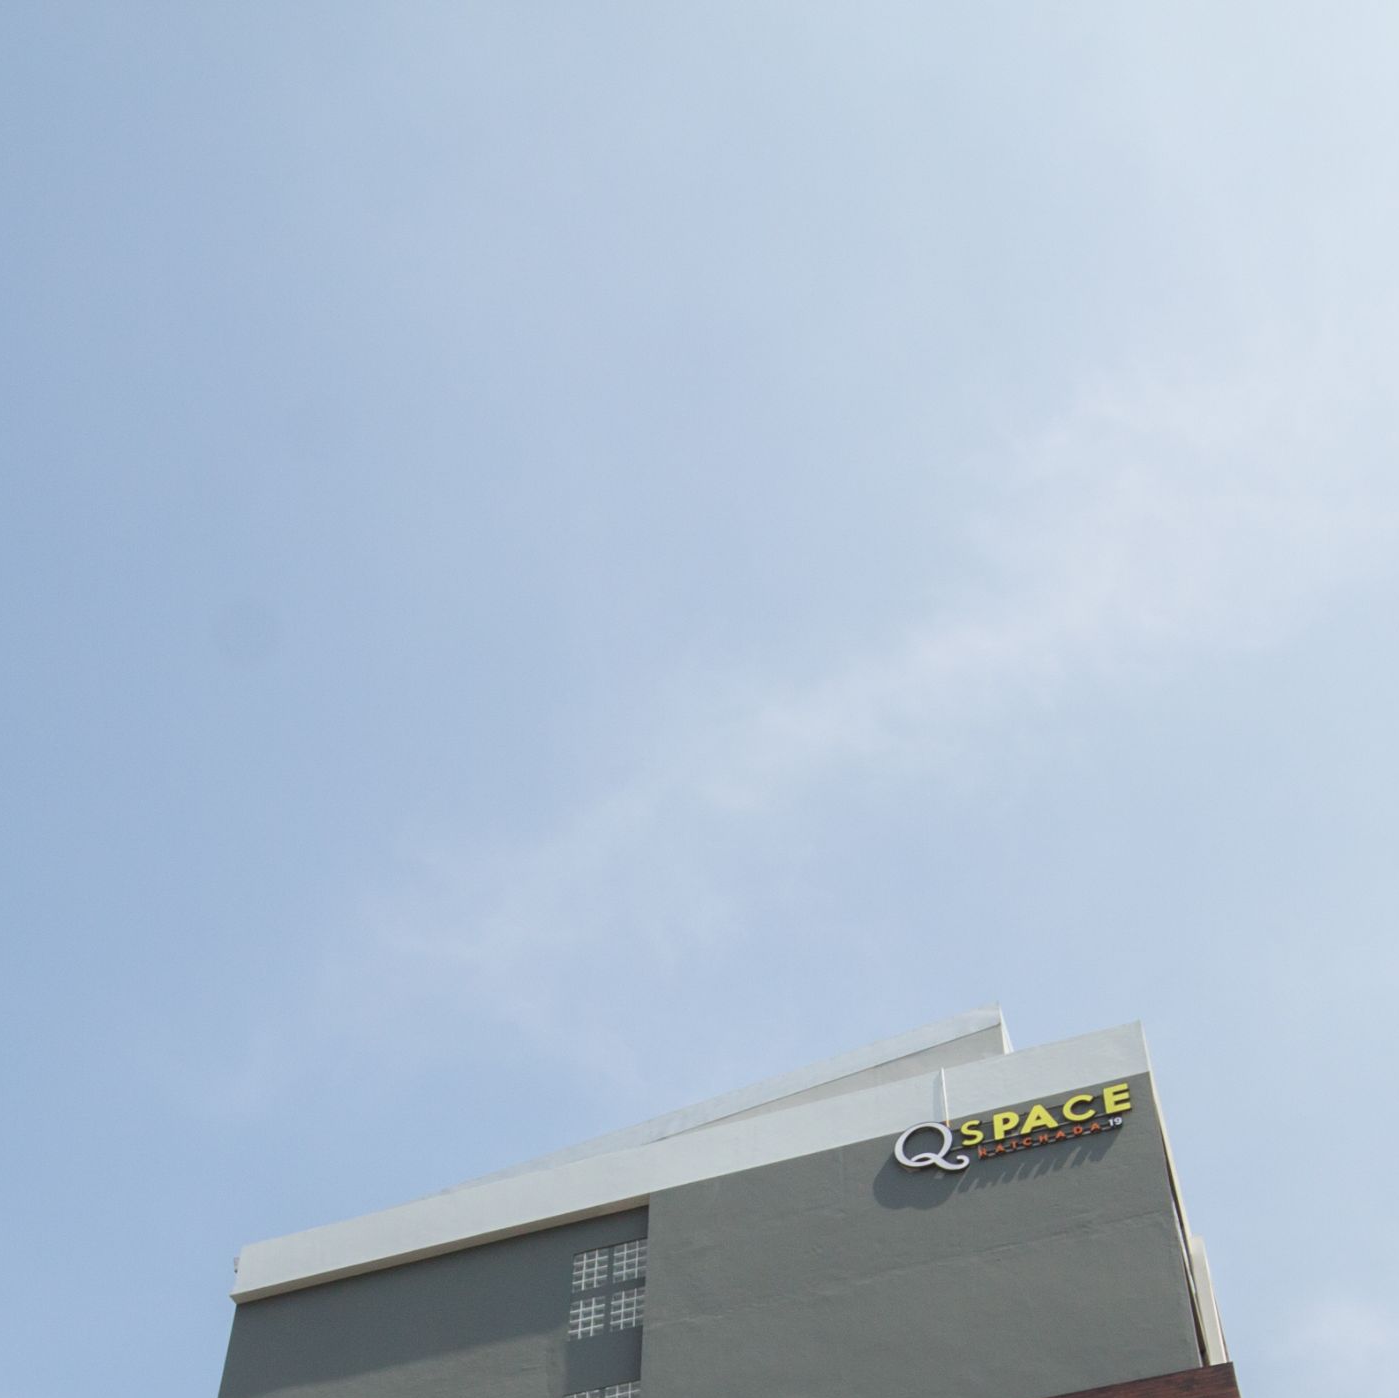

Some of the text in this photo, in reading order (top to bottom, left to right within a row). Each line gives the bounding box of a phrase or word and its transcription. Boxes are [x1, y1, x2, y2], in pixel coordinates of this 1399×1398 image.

[894, 1082, 1133, 1172] Q SPACE
[977, 1116, 1124, 1159] RATCHADA 19
